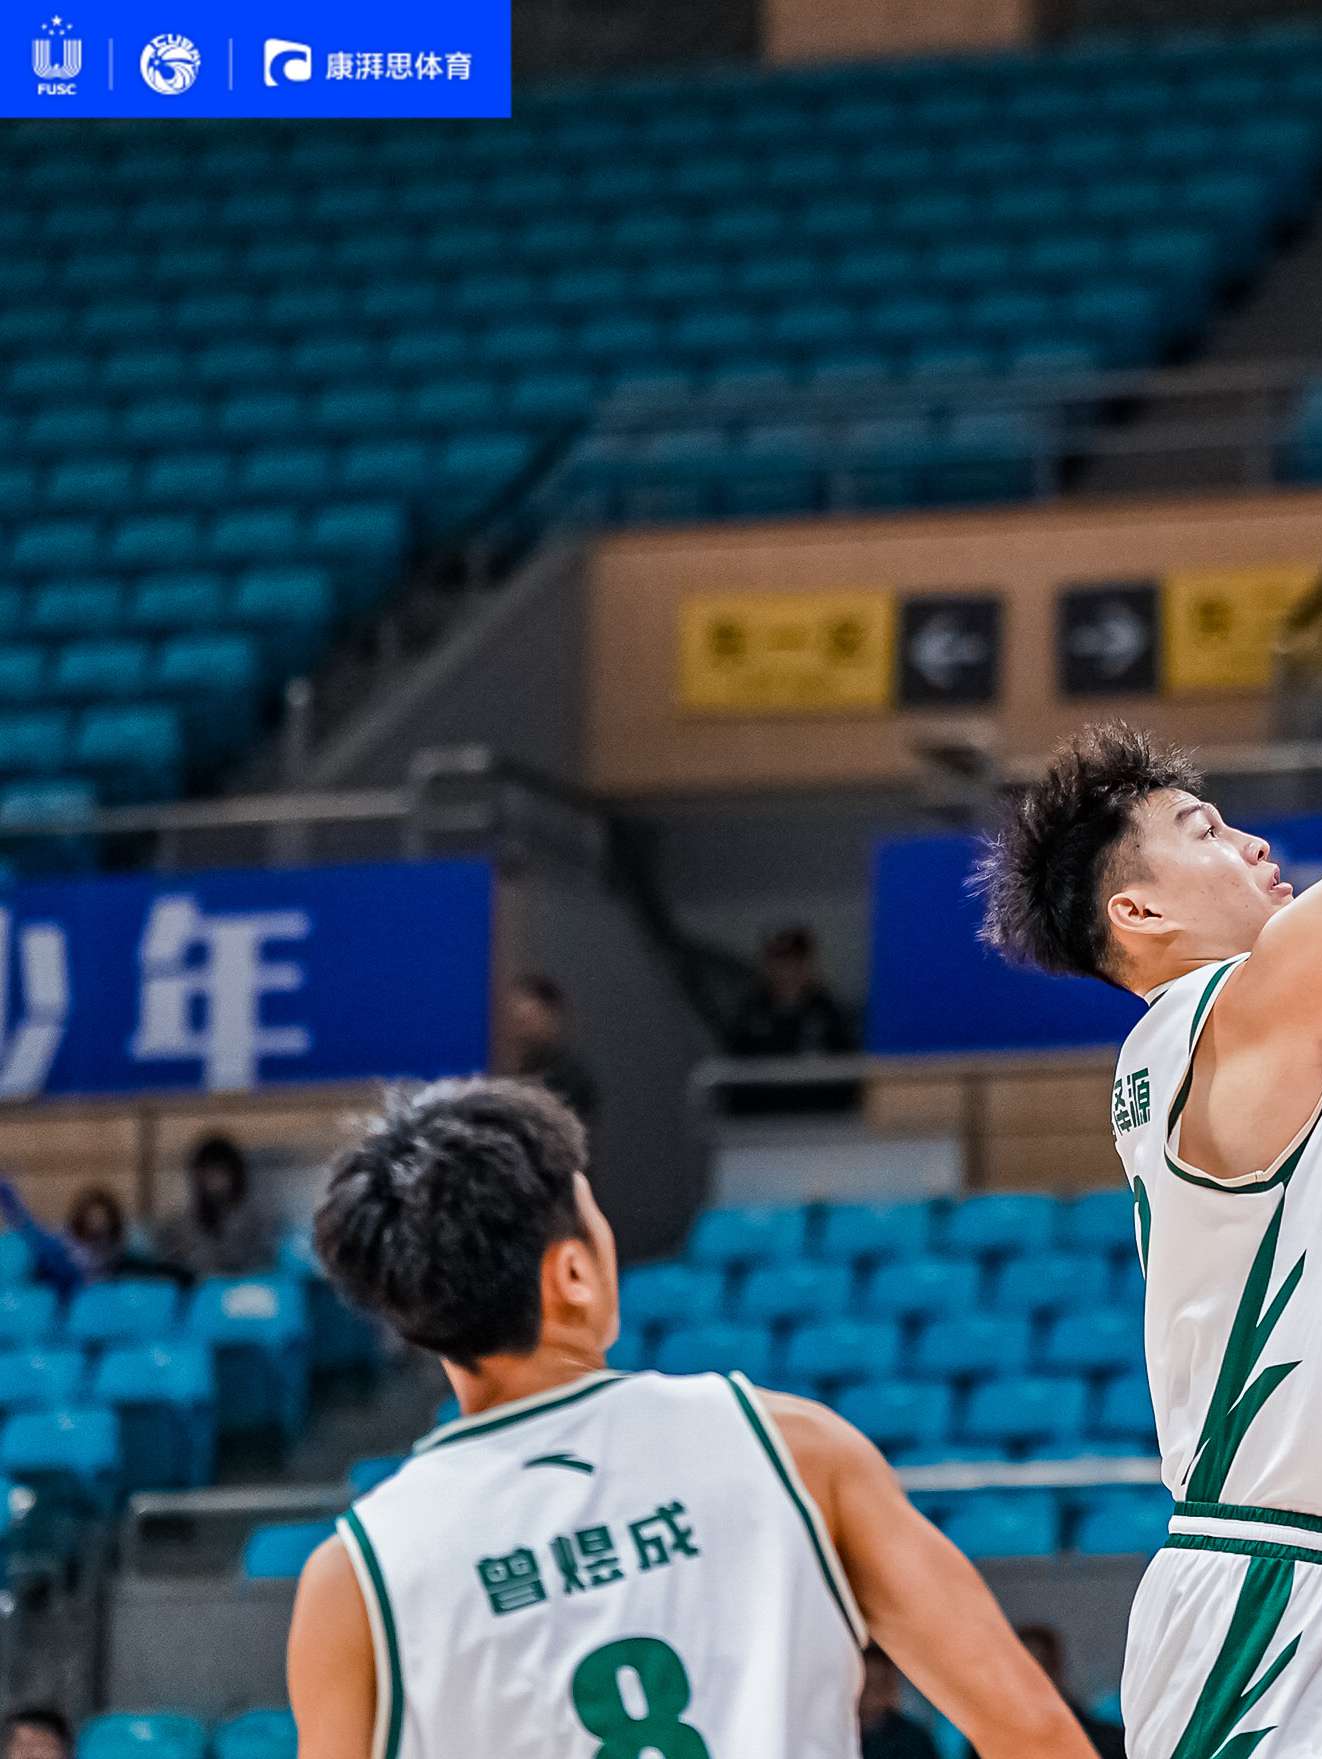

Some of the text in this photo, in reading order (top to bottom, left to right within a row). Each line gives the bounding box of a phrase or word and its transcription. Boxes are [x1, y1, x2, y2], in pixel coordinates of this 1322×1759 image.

[477, 1500, 700, 1616] 曾煜成
[571, 1637, 712, 1759] 8
